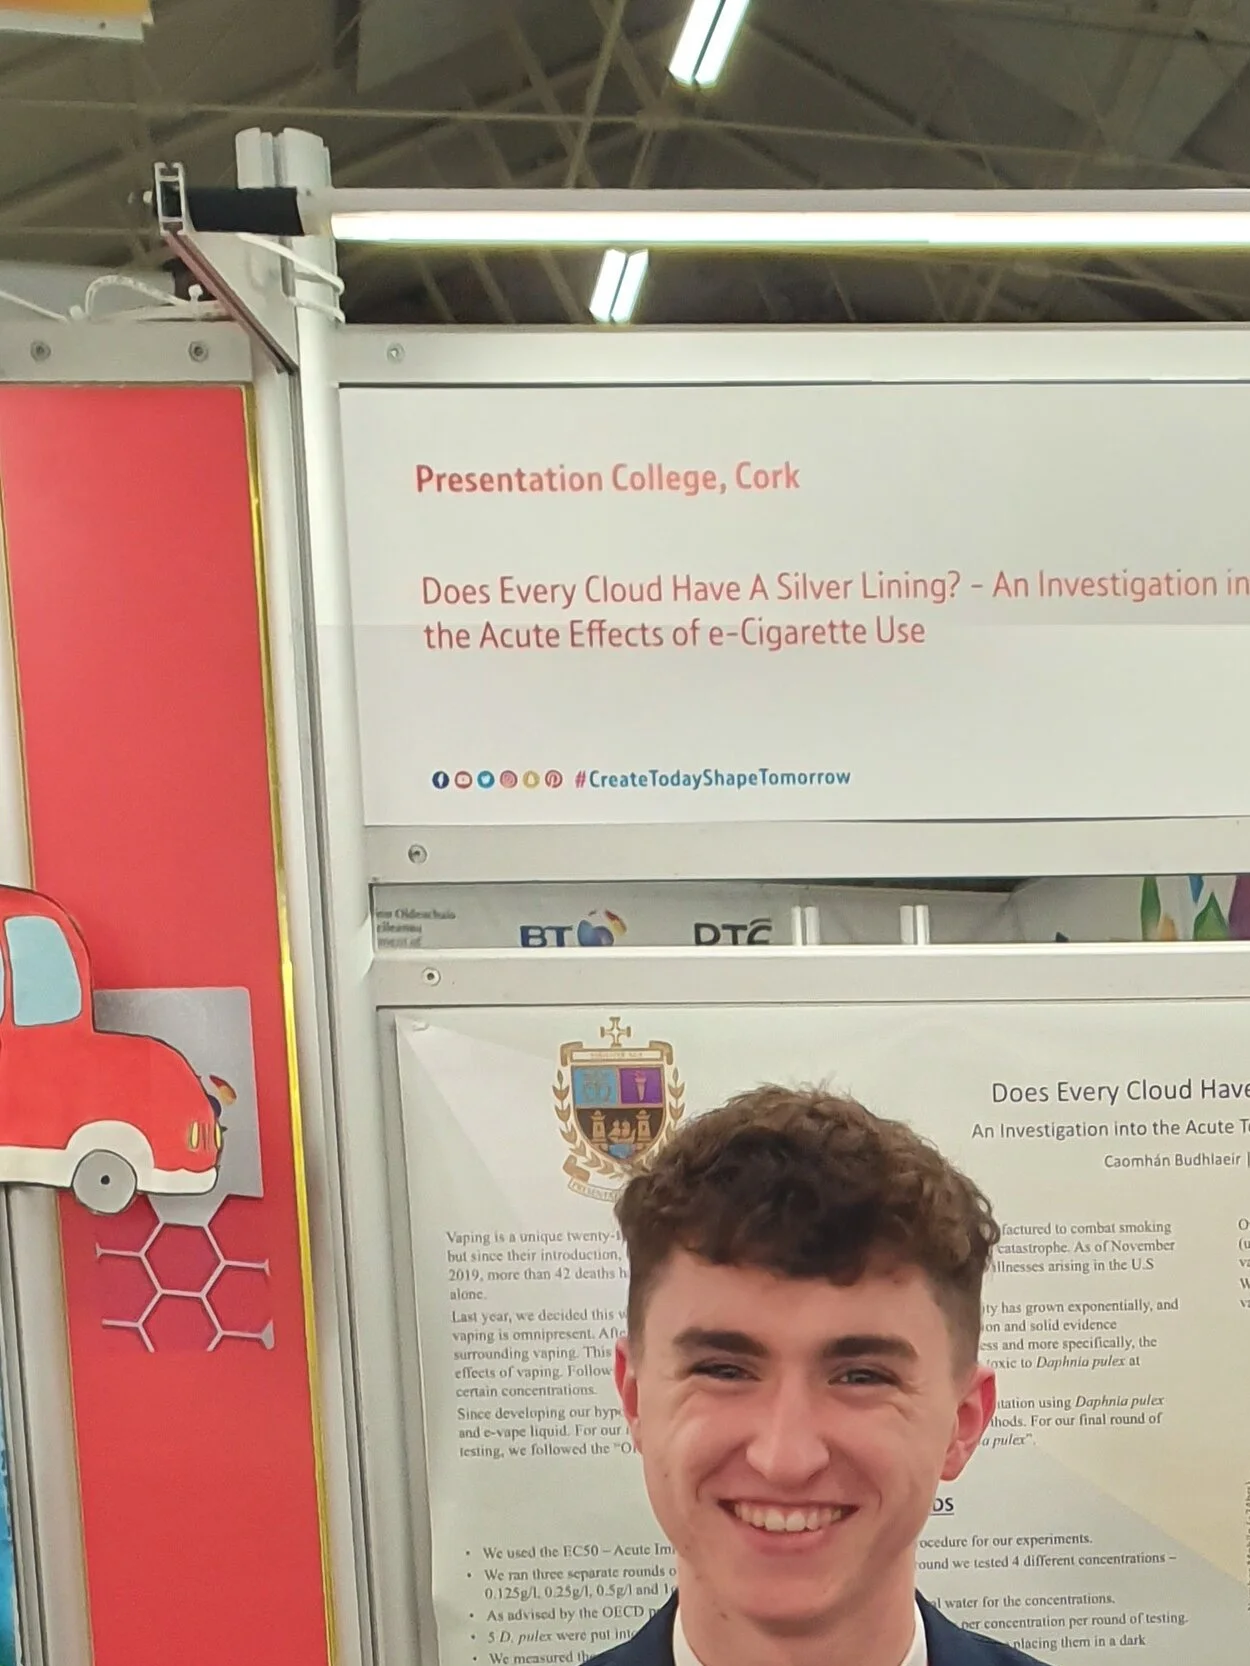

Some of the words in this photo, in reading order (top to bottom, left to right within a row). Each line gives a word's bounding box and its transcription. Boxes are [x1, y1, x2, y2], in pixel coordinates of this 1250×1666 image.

[416, 464, 602, 492] Presentation
[612, 463, 726, 496] College,
[736, 461, 800, 489] Cork
[423, 577, 490, 604] Does
[500, 576, 576, 609] Every
[586, 575, 662, 603] Cloud
[673, 575, 740, 601] Have
[749, 574, 769, 600] A
[777, 572, 853, 600] Silver
[862, 570, 960, 604] Lining?
[993, 571, 1028, 597] An
[1039, 569, 1217, 602] Investigation
[424, 621, 470, 649] the
[480, 621, 560, 648] Acute
[570, 619, 663, 648] Effects
[673, 618, 700, 646] of
[709, 617, 866, 651] e-Cigarette
[877, 616, 925, 643] Use
[575, 768, 850, 790] #CreateTodayShapeTomorrow
[520, 925, 573, 947] BT
[993, 1083, 1048, 1102] Does
[1058, 1082, 1119, 1106] Every
[1127, 1078, 1191, 1100] Cloud
[972, 1124, 994, 1138] An
[1001, 1122, 1108, 1141] Investigation
[1115, 1121, 1147, 1136] into
[1153, 1119, 1180, 1135] the
[1186, 1120, 1234, 1134] Acute
[1105, 1154, 1170, 1168] Caomhán
[1071, 1221, 1115, 1234] combat
[1119, 1220, 1171, 1235] smoking
[446, 1231, 490, 1246] Vaping
[495, 1231, 505, 1242] is
[509, 1234, 516, 1243] a
[520, 1233, 562, 1245] unique
[1111, 1239, 1175, 1252] November
[447, 1250, 467, 1262] but
[471, 1253, 503, 1262] since
[508, 1249, 536, 1261] their
[541, 1248, 621, 1261] introduction,
[448, 1269, 483, 1281] 2019,
[488, 1272, 520, 1280] more
[524, 1268, 550, 1280] than
[555, 1267, 570, 1279] 42
[575, 1266, 615, 1279] deaths
[1026, 1304, 1064, 1316] grown
[1068, 1298, 1152, 1315] exponentially,
[451, 1311, 477, 1323] Last
[482, 1312, 512, 1325] year,
[516, 1313, 534, 1321] we
[538, 1308, 587, 1321] decided
[592, 1308, 614, 1320] this
[1063, 1319, 1117, 1331] evidence
[513, 1328, 595, 1343] omnipresent.
[1063, 1336, 1135, 1352] specifically,
[1037, 1355, 1089, 1371] Daphnia
[1092, 1355, 1125, 1370] pulex
[456, 1388, 497, 1397] certain
[501, 1384, 597, 1397] concentrations.
[457, 1408, 491, 1420] Since
[495, 1407, 565, 1422] developing
[1016, 1534, 1092, 1548] experiments.
[483, 1547, 502, 1559] We
[507, 1546, 535, 1558] used
[540, 1546, 559, 1557] the
[563, 1545, 598, 1557] EC50
[614, 1545, 650, 1556] Acute
[974, 1556, 1008, 1568] tested
[1012, 1556, 1019, 1566] 4
[1024, 1555, 1075, 1566] different
[1079, 1552, 1165, 1565] concentrations
[984, 1616, 1065, 1629] concentration
[1146, 1612, 1188, 1625] testing.
